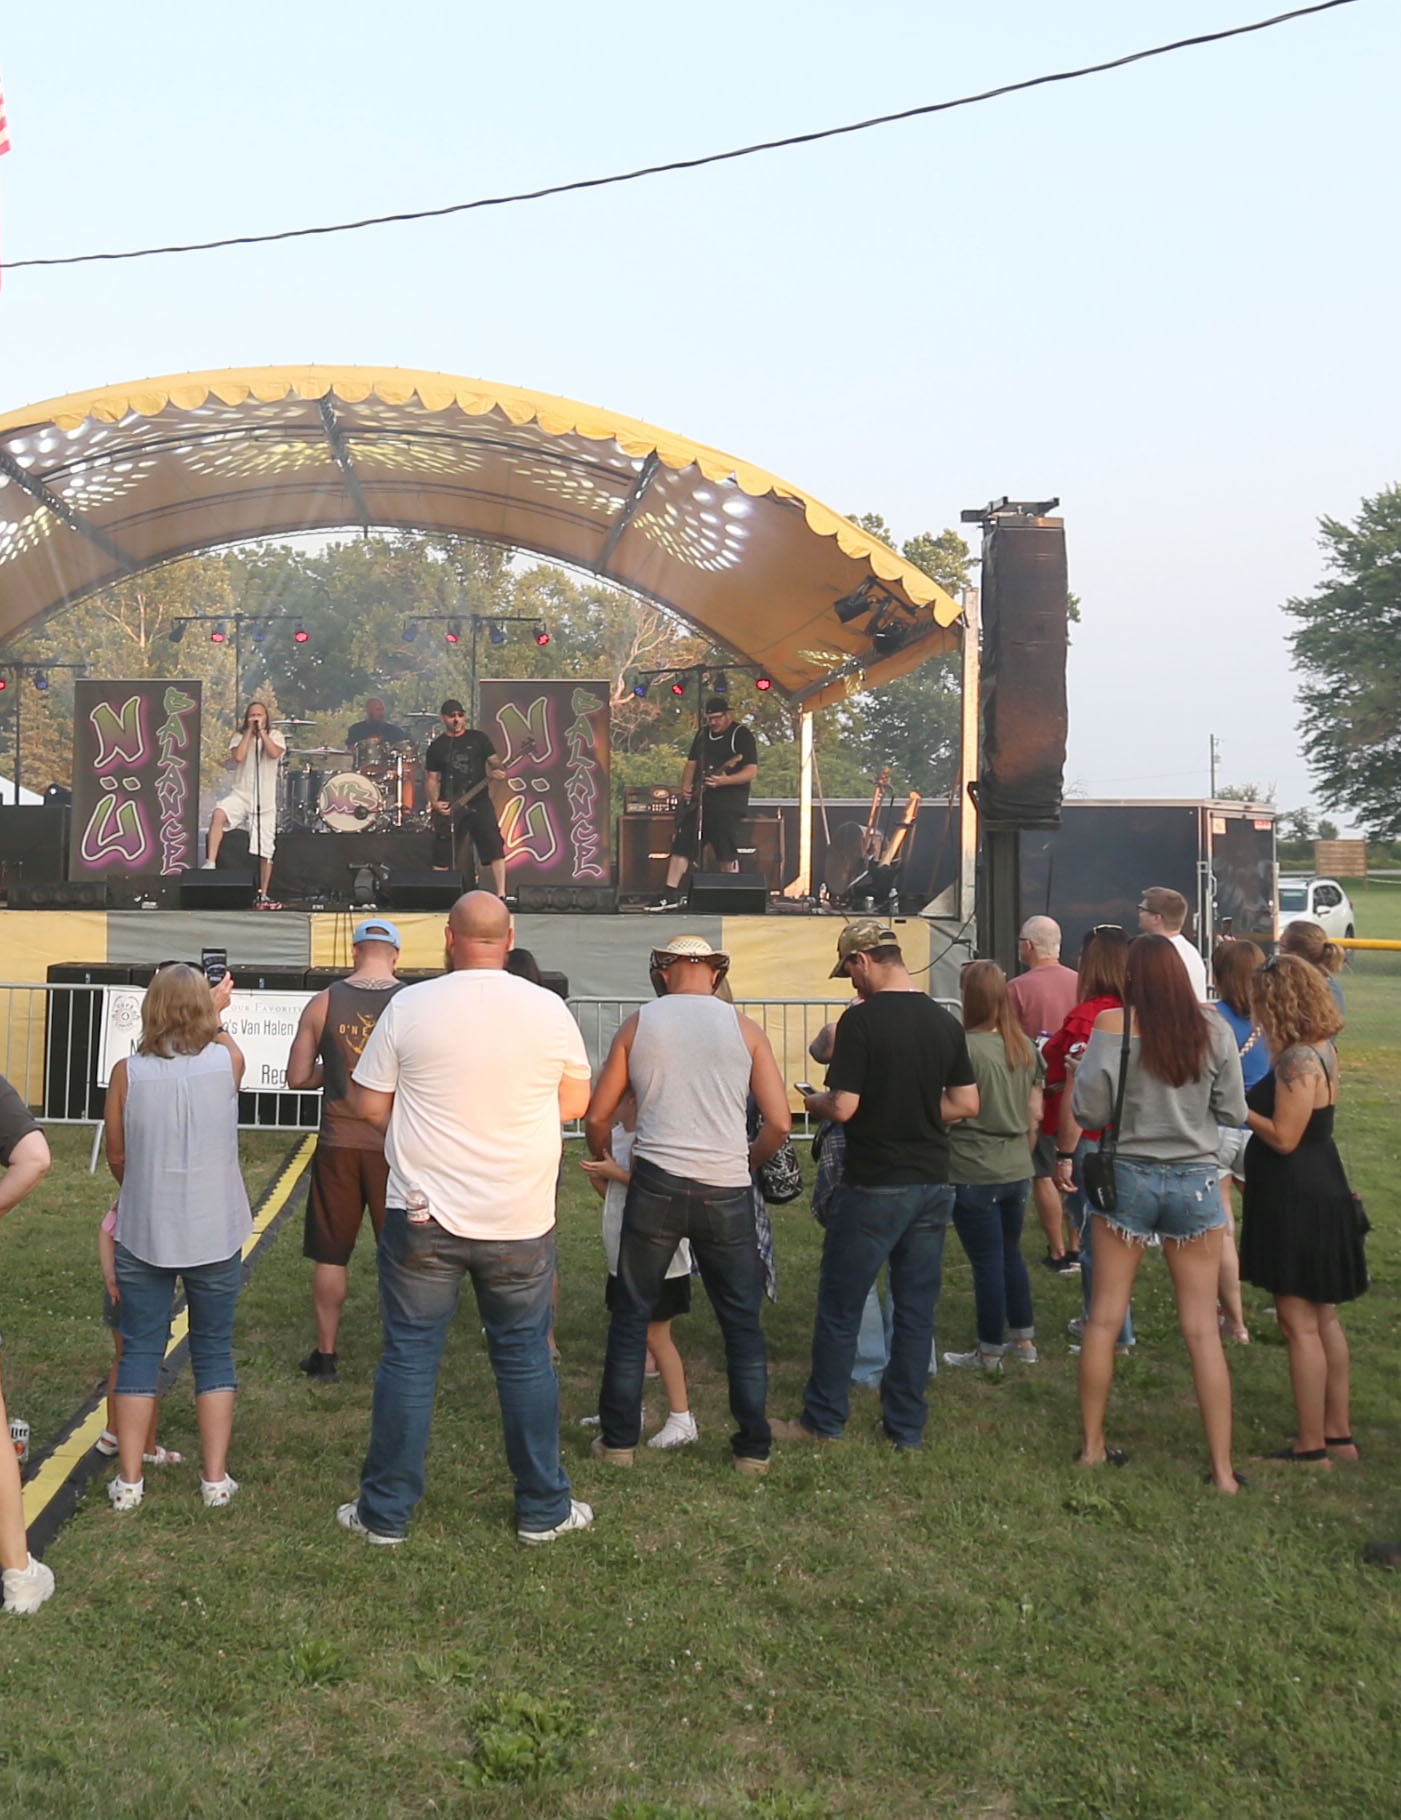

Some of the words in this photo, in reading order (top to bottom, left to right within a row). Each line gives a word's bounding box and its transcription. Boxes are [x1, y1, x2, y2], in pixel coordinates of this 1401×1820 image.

[155, 686, 197, 876] BALANCE
[564, 687, 604, 878] BALANCE
[241, 1019, 261, 1036] Van
[263, 1019, 294, 1036] Halen
